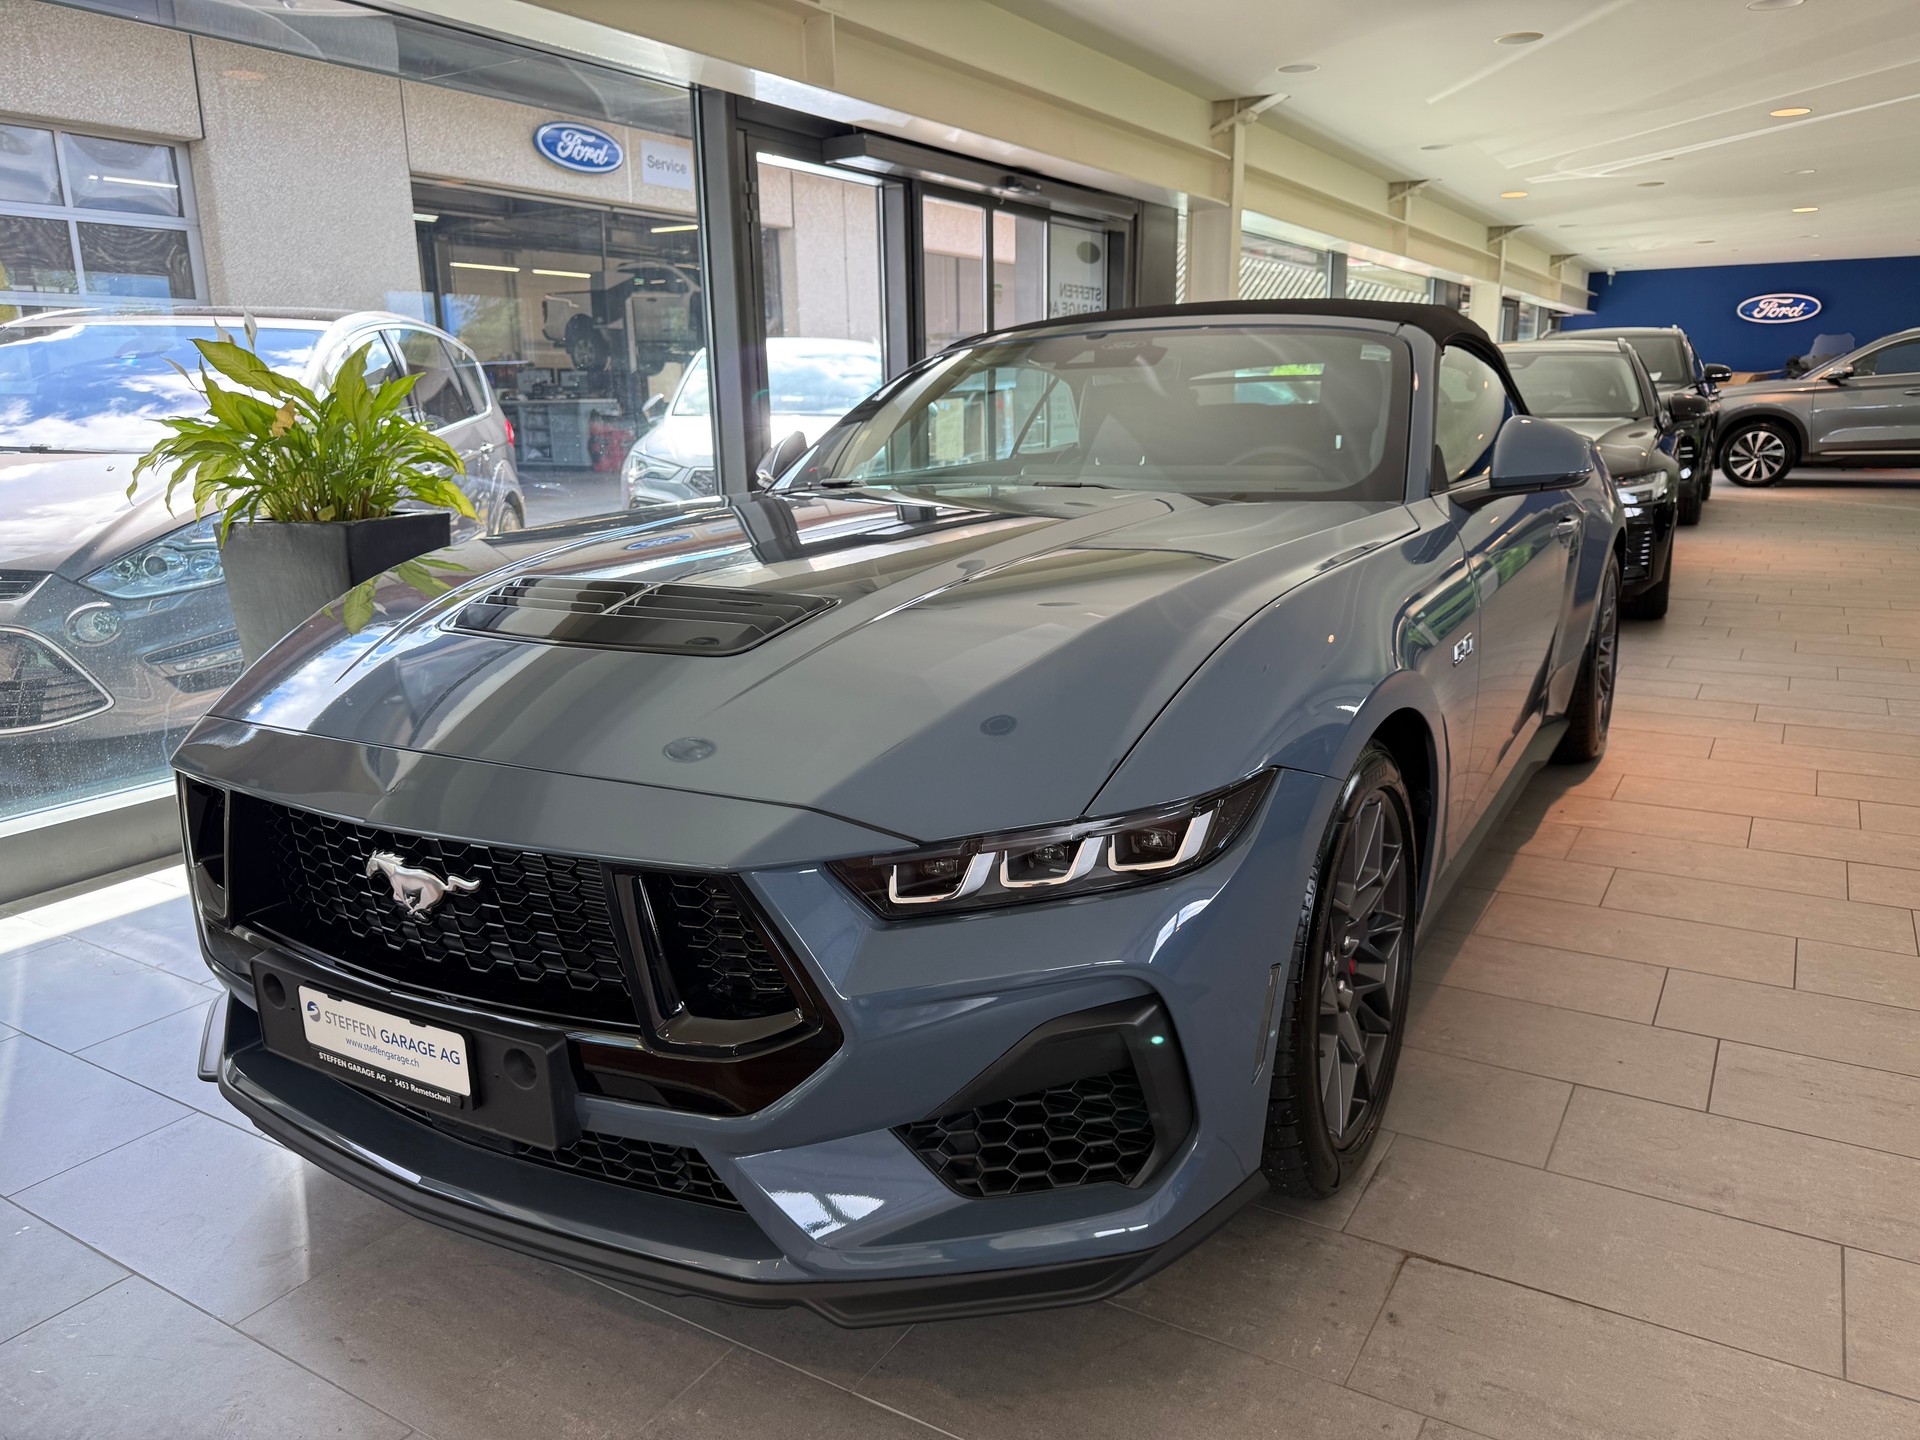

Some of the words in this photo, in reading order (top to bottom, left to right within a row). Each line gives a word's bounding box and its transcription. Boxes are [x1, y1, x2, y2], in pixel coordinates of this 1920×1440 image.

[556, 129, 609, 166] Ford
[646, 155, 688, 175] Service
[1752, 298, 1806, 319] Ford
[324, 1010, 377, 1040] STEFFEN
[380, 1029, 437, 1059] GARAGE
[440, 1048, 461, 1066] AG
[345, 1037, 420, 1068] www.steffengarage.ch
[318, 1051, 347, 1069] STEFFEN
[347, 1062, 376, 1079] GARAGE
[376, 1072, 387, 1083] AG
[394, 1078, 410, 1090] 5453
[410, 1083, 451, 1104] Remetschwil
